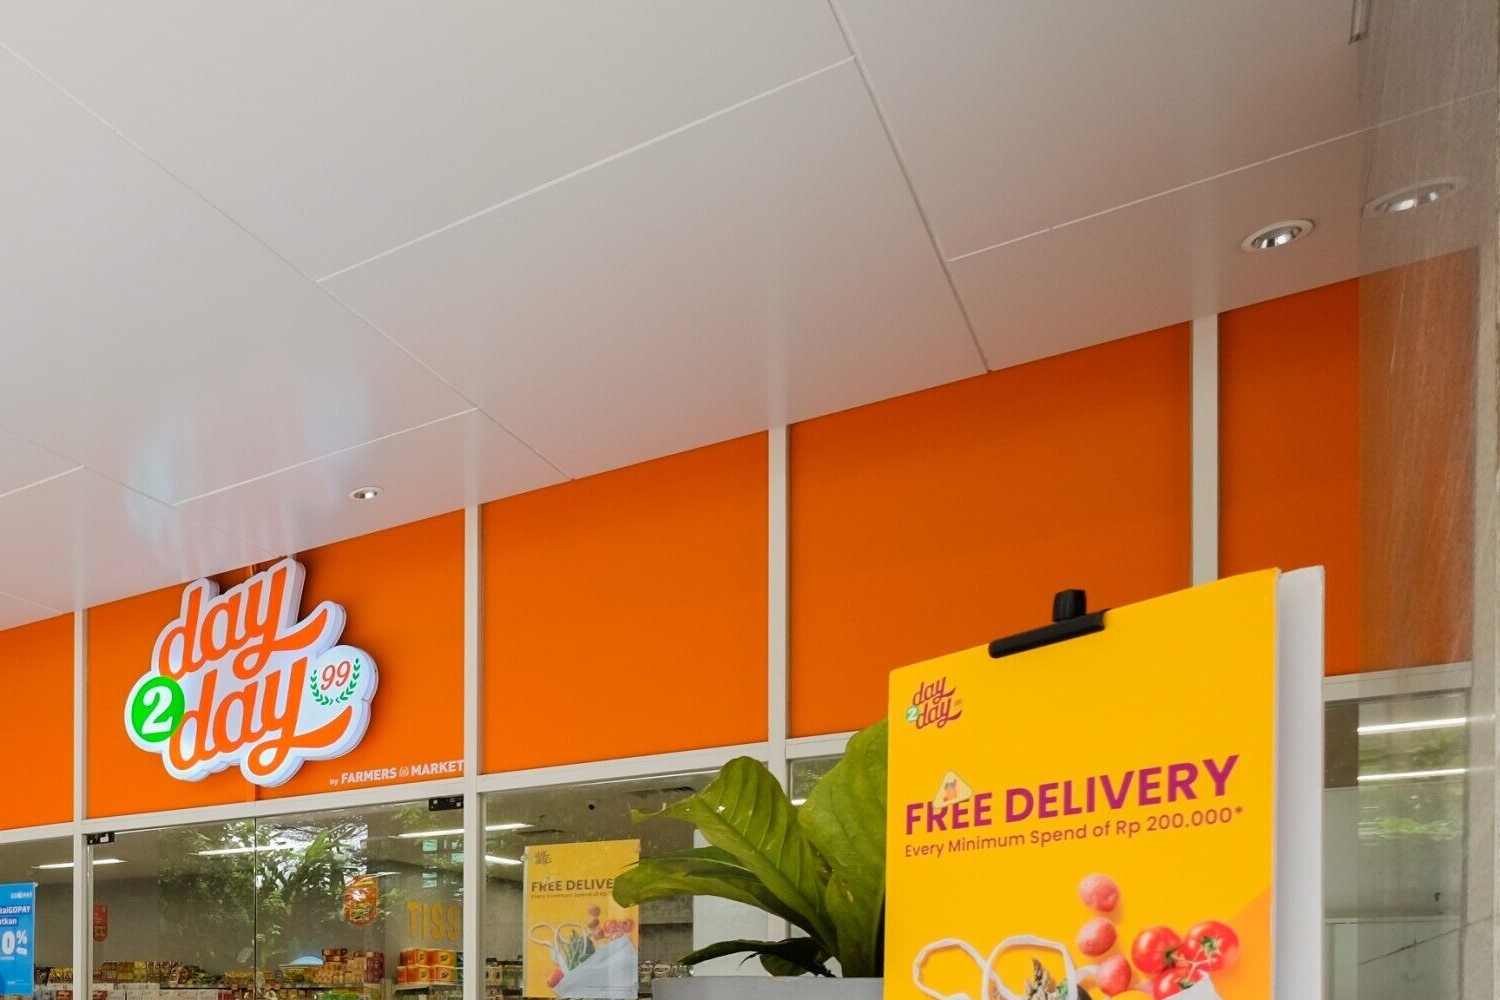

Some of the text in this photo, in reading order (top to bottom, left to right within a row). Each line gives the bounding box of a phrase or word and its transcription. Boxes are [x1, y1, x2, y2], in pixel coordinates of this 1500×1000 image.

[159, 566, 328, 680] day
[320, 661, 351, 692] 99
[913, 676, 956, 707] day
[141, 656, 353, 777] 2 day
[916, 698, 963, 730] day
[341, 768, 397, 785] FARMERS
[411, 760, 464, 777] MARKET
[905, 754, 1240, 836] FREE DELIVERY
[905, 843, 944, 859] Every
[948, 833, 1025, 853] Minimum
[1030, 823, 1087, 848] Spend
[1092, 821, 1111, 837] of
[1116, 820, 1141, 838] Rp
[531, 878, 613, 893] FREE DELIVE
[405, 899, 463, 942] TISS
